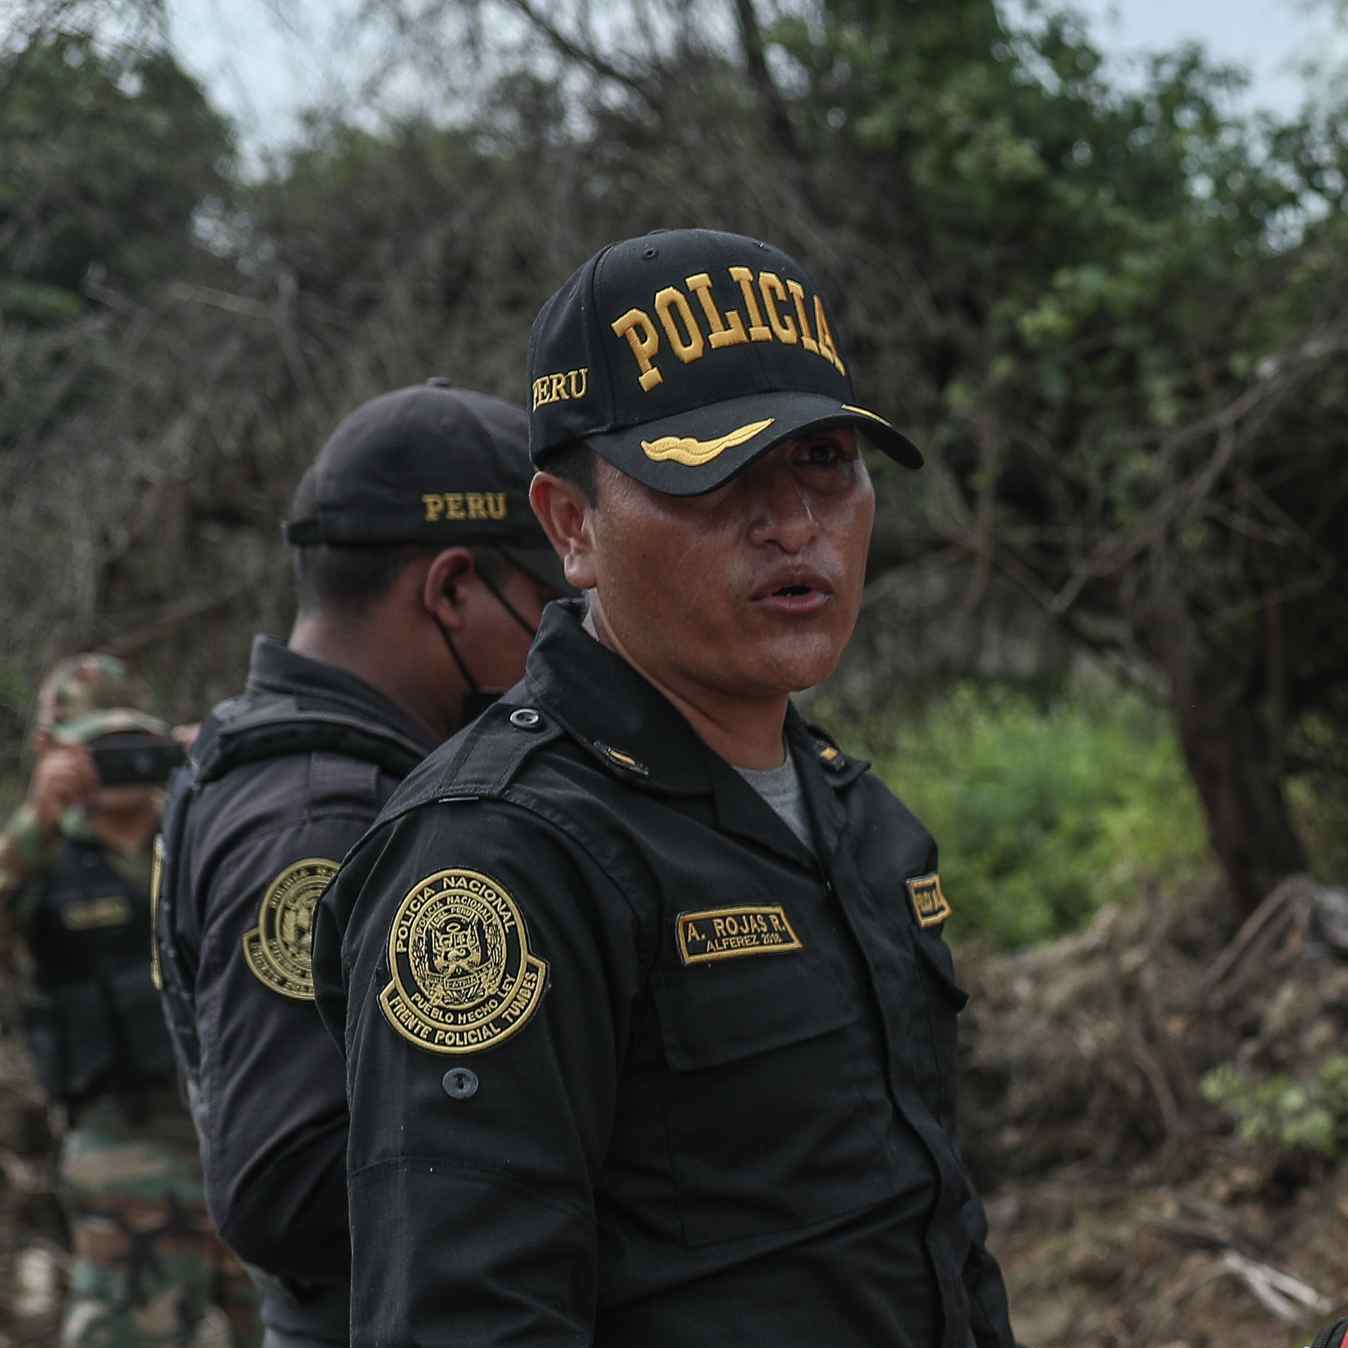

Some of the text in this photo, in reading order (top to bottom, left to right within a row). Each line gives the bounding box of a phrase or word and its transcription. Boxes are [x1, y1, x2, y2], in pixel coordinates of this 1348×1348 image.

[611, 266, 847, 393] POLICIA
[422, 492, 508, 522] PERU
[396, 886, 435, 953] POLICIA
[443, 876, 516, 933] NACIONAL
[447, 895, 492, 921] NACIONAL
[687, 922, 705, 942] A.
[713, 914, 768, 937] ROJAS
[706, 934, 760, 952] ALFEREZ
[389, 971, 538, 1046] FRENTE POLICIAL TUMBES
[410, 974, 516, 1024] PUEBLO HECHO LEY
